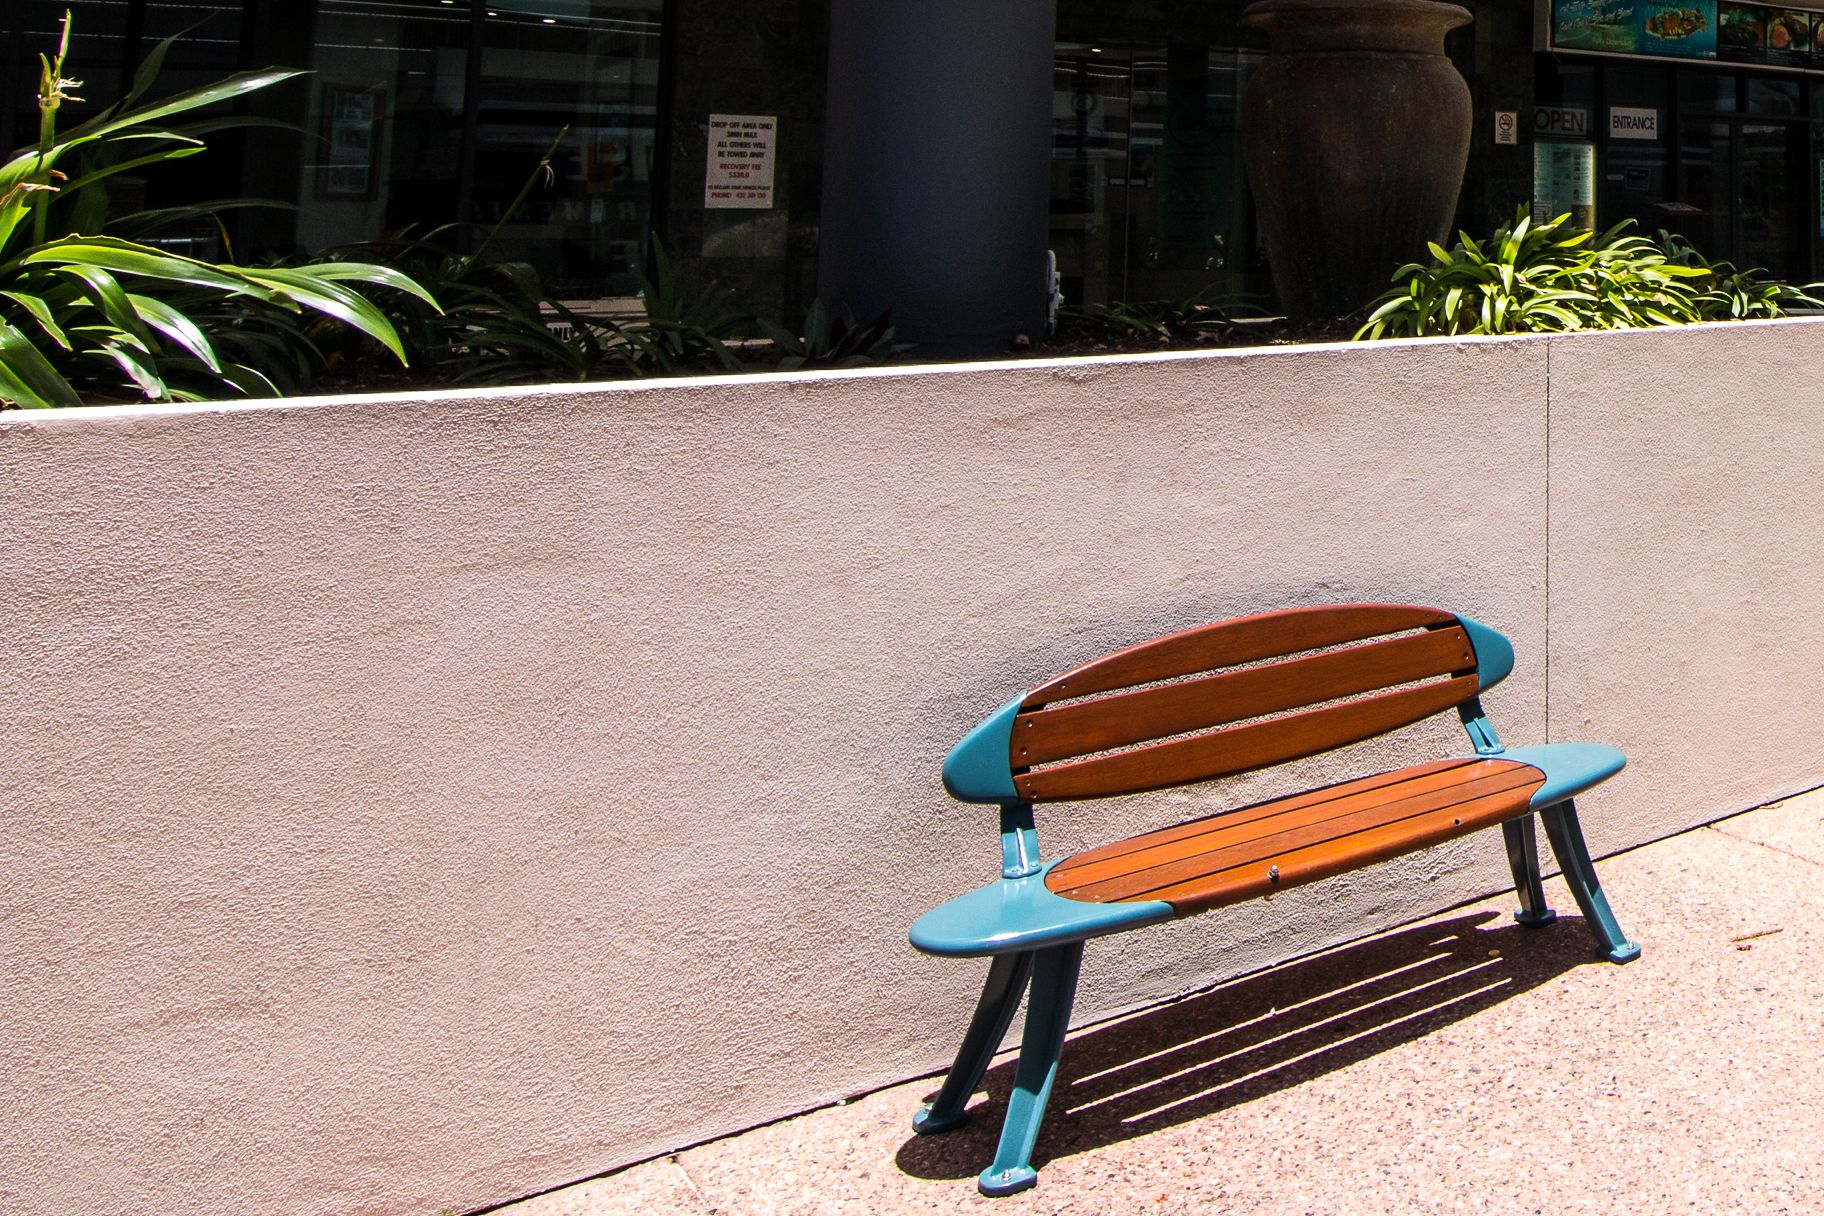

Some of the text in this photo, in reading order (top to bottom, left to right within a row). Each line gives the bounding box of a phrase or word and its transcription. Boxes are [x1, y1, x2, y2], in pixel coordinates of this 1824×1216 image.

[711, 121, 728, 129] DROP
[729, 121, 740, 129] OFF
[1535, 109, 1584, 131] OPEN
[1612, 115, 1655, 130] ENTRANCE
